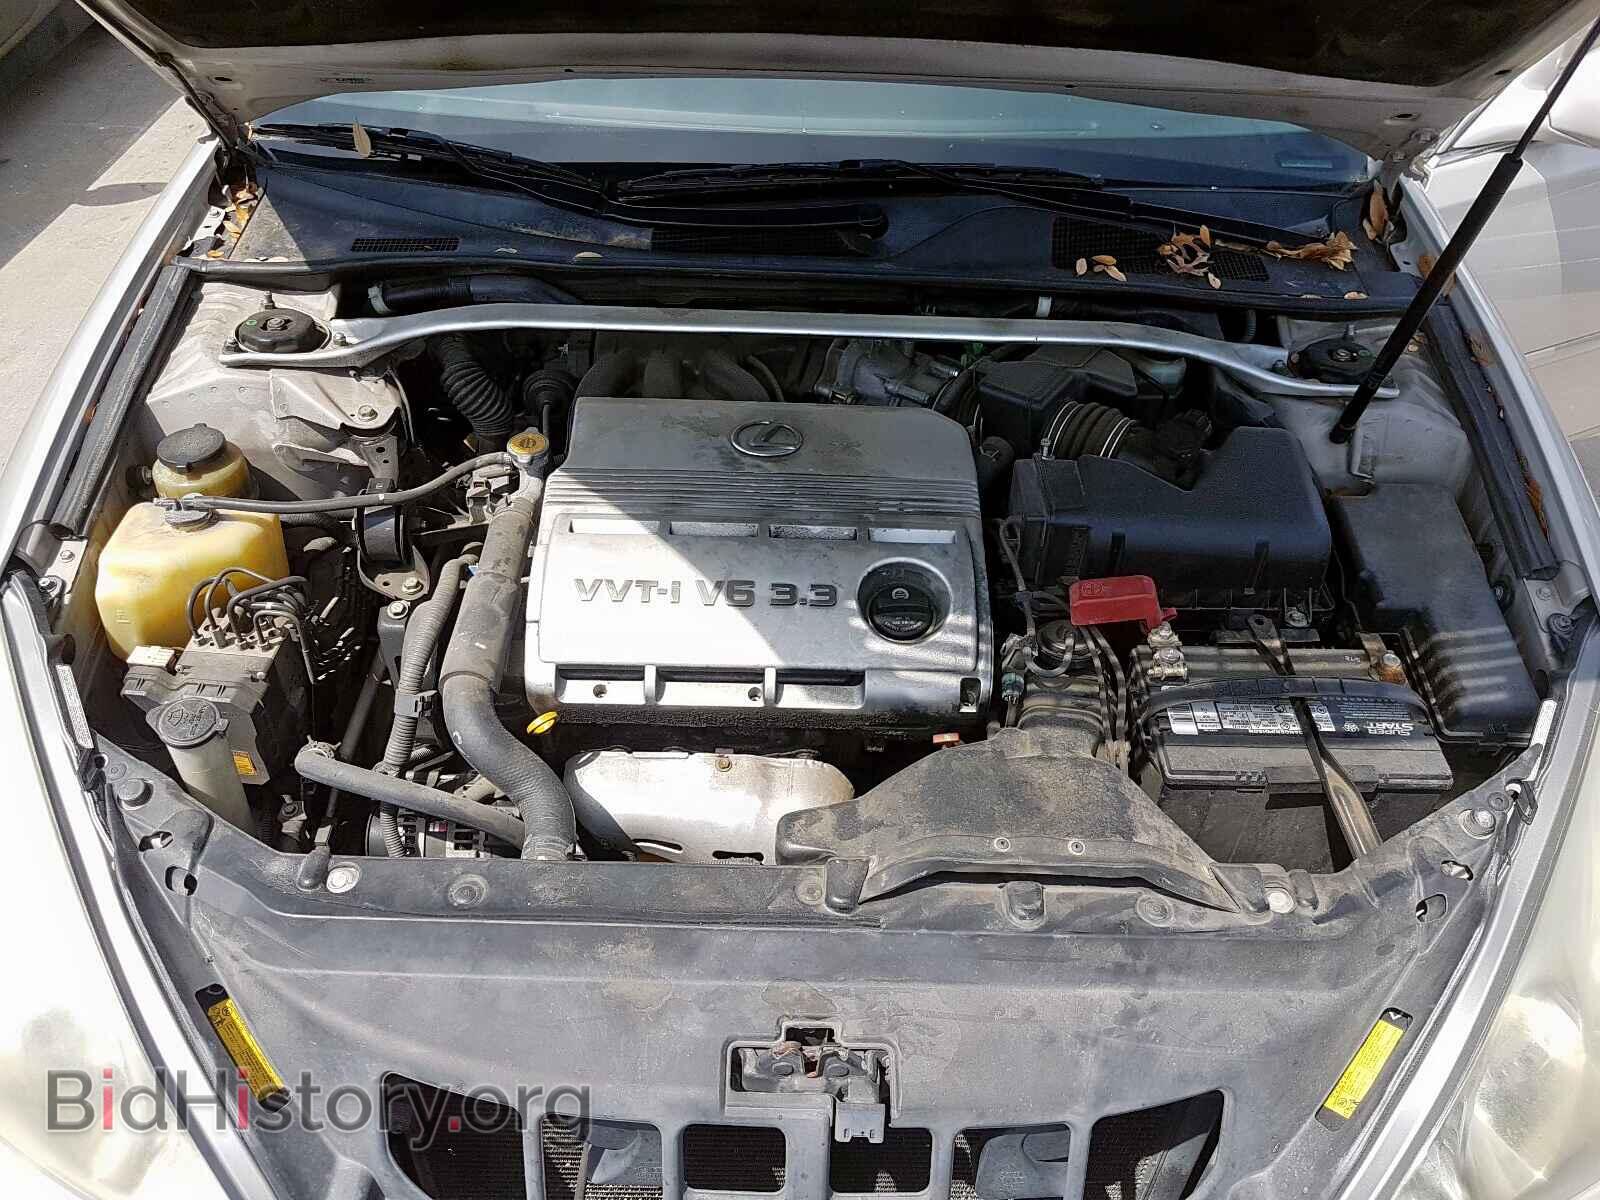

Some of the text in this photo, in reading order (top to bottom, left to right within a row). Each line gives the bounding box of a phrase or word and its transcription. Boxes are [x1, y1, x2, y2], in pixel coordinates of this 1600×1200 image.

[695, 580, 756, 607] V6
[769, 583, 838, 607] 3.3
[1365, 721, 1415, 732] START
[1367, 728, 1411, 737] SUPER
